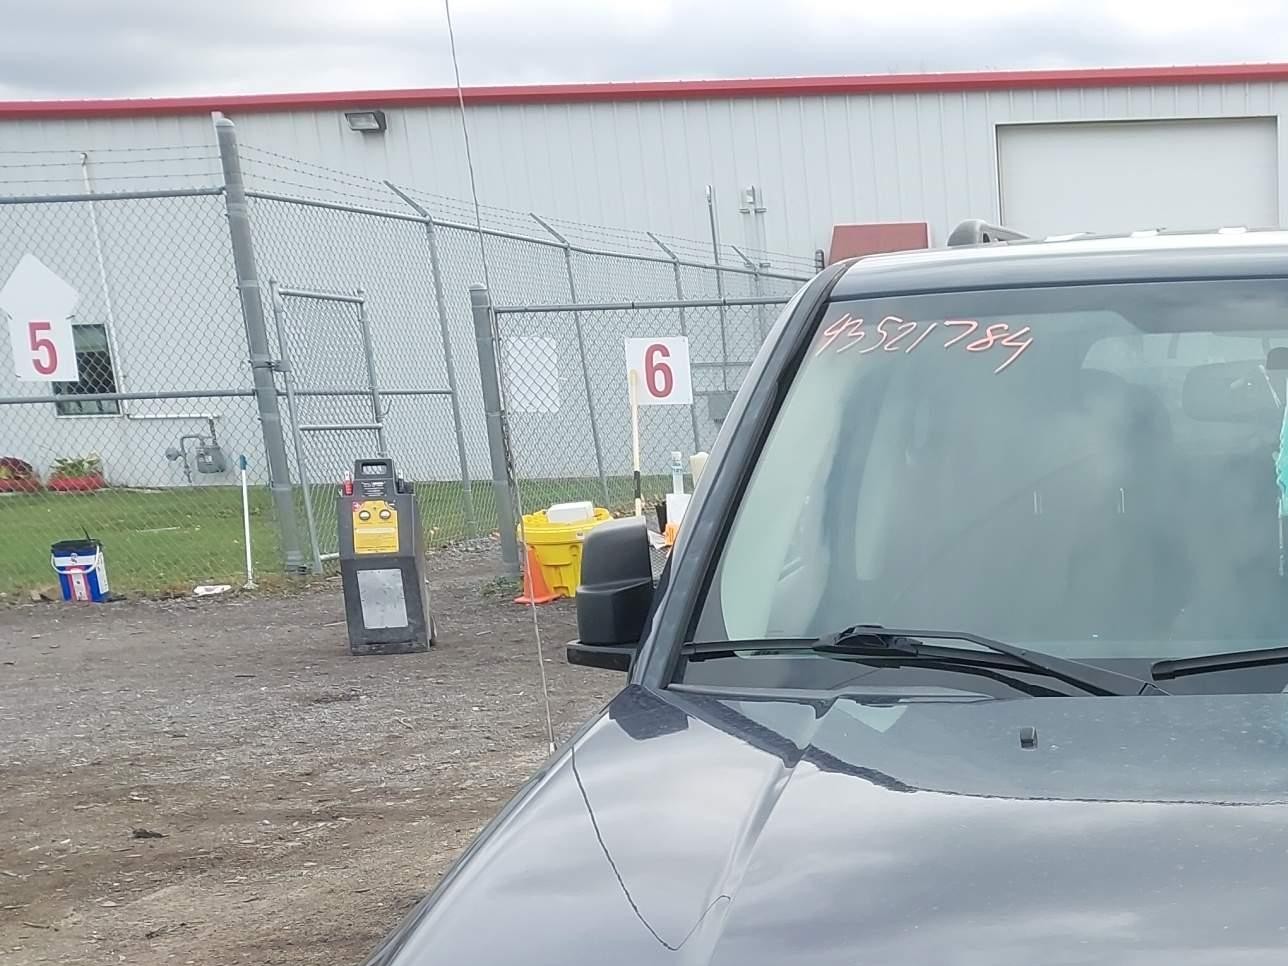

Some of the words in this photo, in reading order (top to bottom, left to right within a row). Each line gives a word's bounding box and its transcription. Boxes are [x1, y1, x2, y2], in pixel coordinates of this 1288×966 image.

[28, 322, 58, 375] 5
[645, 343, 674, 398] 6
[815, 313, 1034, 374] 43521784
